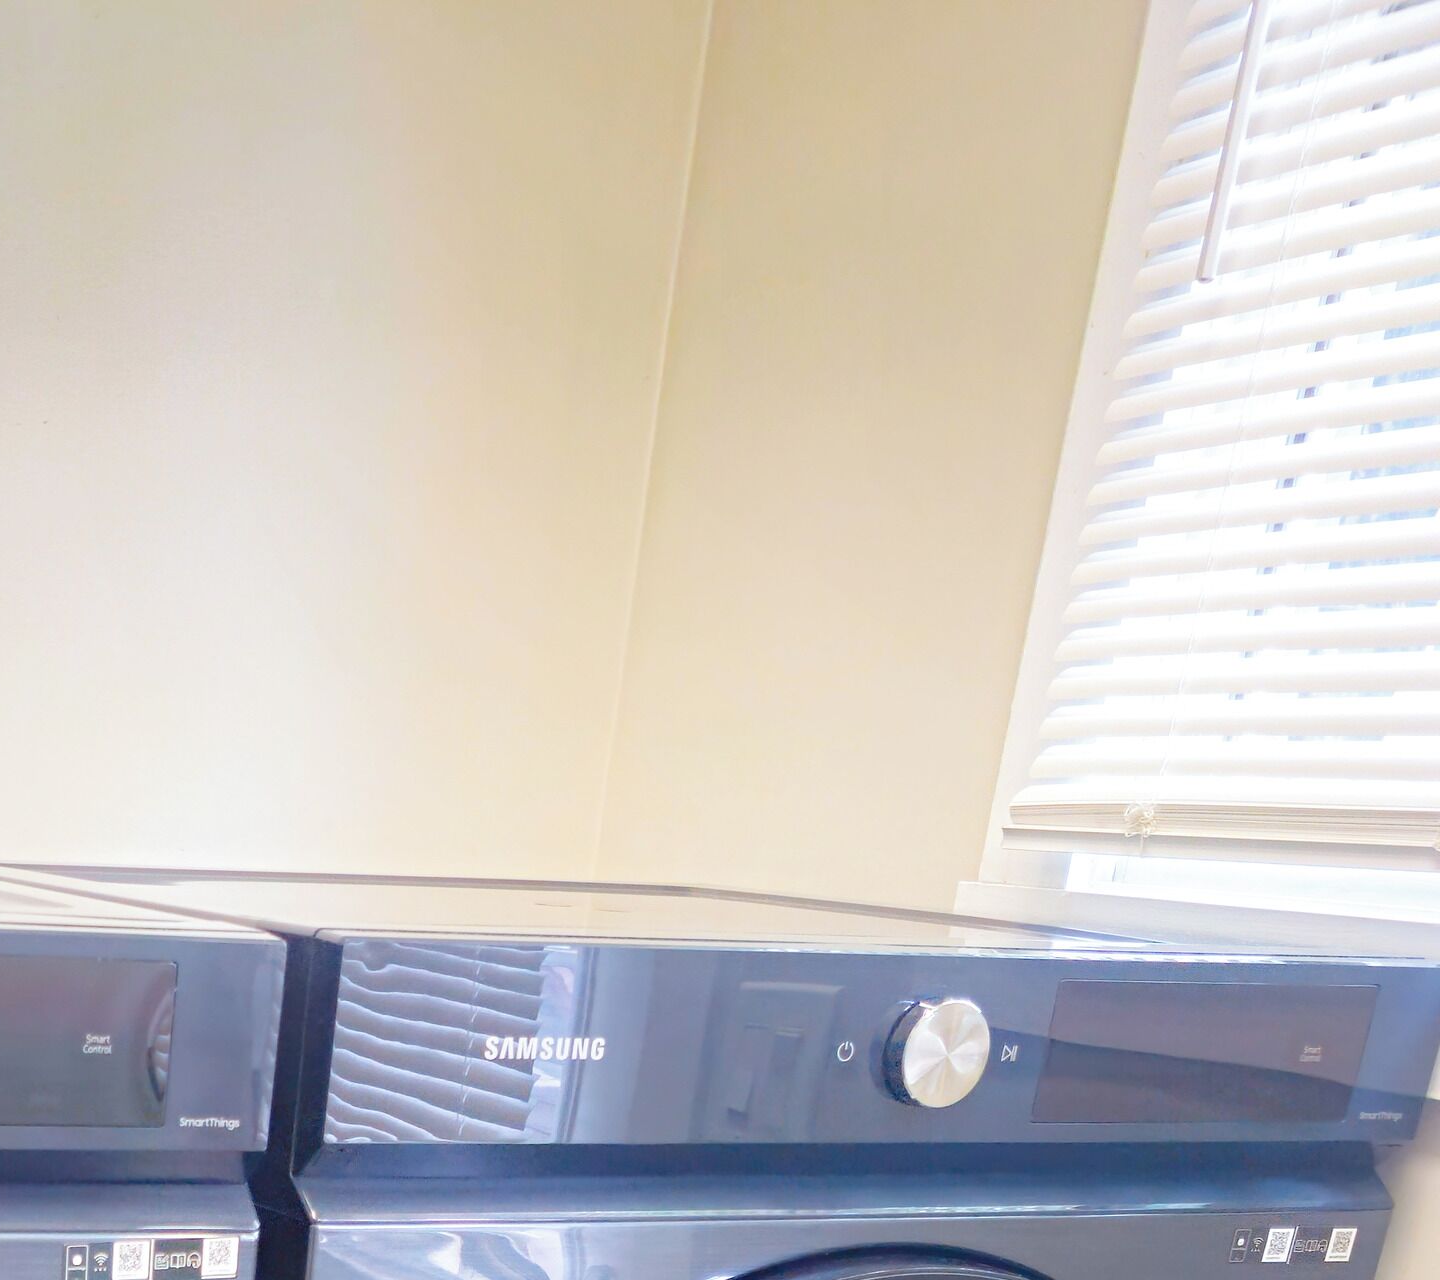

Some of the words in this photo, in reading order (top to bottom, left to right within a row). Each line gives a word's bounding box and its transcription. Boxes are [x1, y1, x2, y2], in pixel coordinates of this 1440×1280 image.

[86, 1034, 111, 1044] Smart
[82, 1044, 112, 1055] Control
[484, 1036, 606, 1061] SAMSUNG
[179, 1116, 241, 1130] SmartThings
